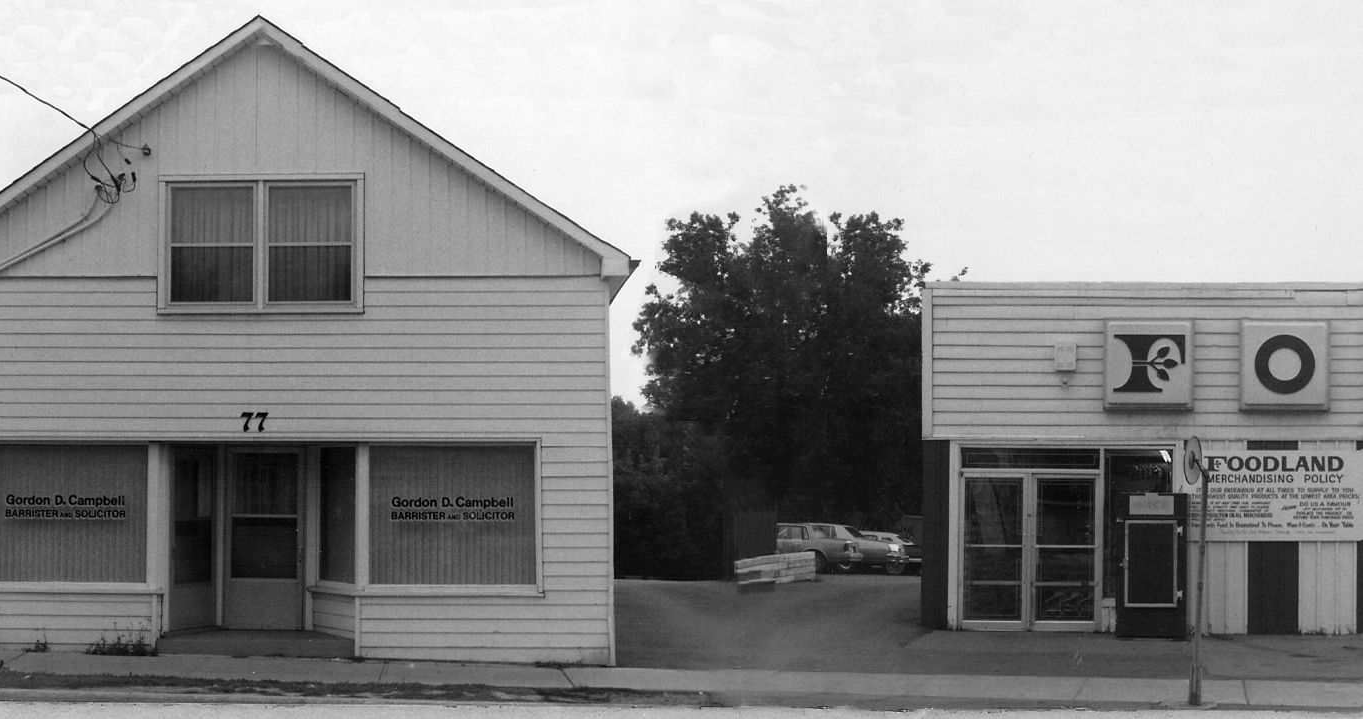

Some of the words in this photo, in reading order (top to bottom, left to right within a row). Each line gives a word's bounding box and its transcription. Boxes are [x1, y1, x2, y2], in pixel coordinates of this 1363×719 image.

[240, 412, 268, 432] 77
[1204, 456, 1344, 472] FOODLAND
[1208, 474, 1294, 483] MERCHANDISING
[1304, 474, 1344, 483] POLICY
[6, 494, 50, 506] Gordon
[55, 494, 67, 506] D.
[68, 494, 125, 507] Campbell
[391, 496, 437, 508] Gordon
[441, 496, 454, 508] D.
[455, 496, 514, 509] Campbell
[5, 509, 59, 518] BARRISTER
[74, 509, 126, 518] SOLICITOR
[391, 511, 446, 520] BARRISTER
[462, 511, 515, 520] SOLICITOR
